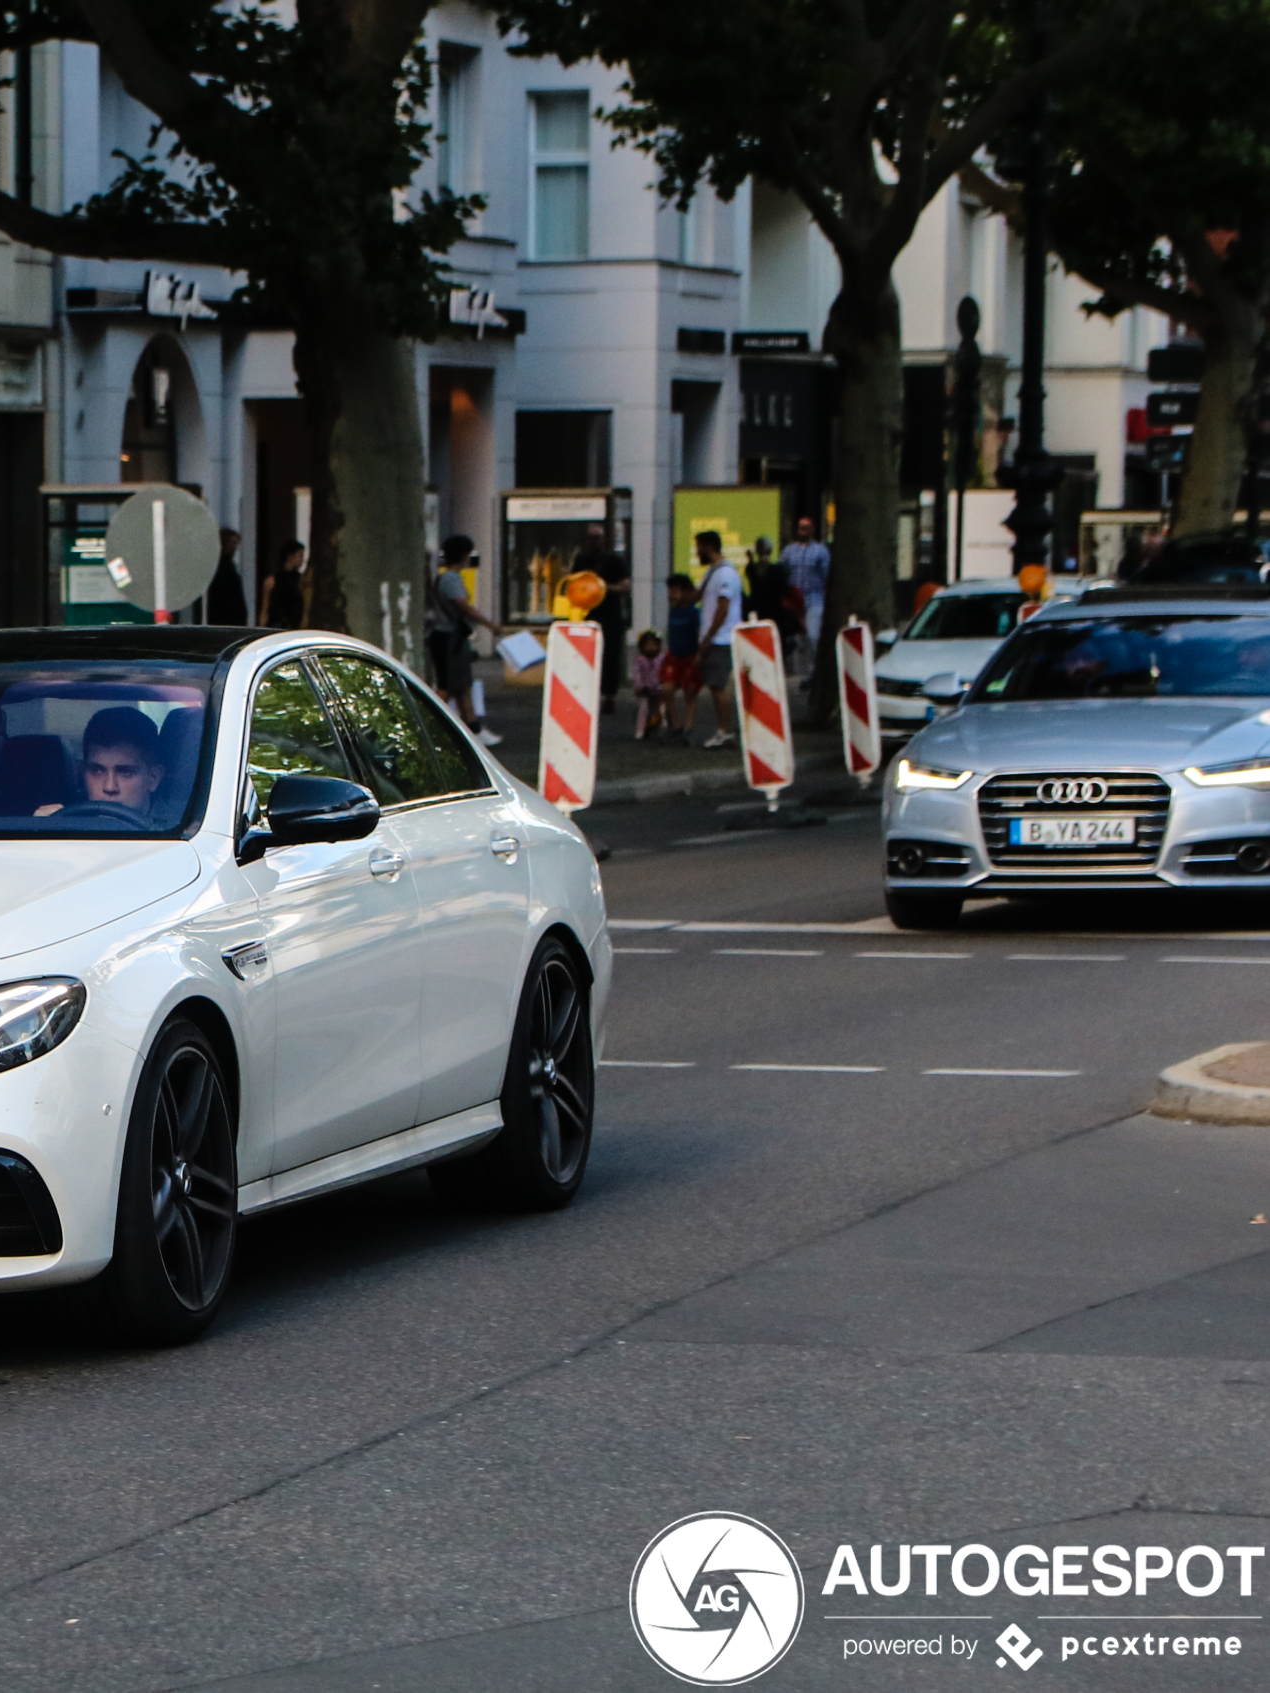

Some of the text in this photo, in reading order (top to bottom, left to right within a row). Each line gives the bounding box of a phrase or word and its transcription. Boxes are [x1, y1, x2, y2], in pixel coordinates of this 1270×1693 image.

[1030, 822, 1123, 841] B YA 244
